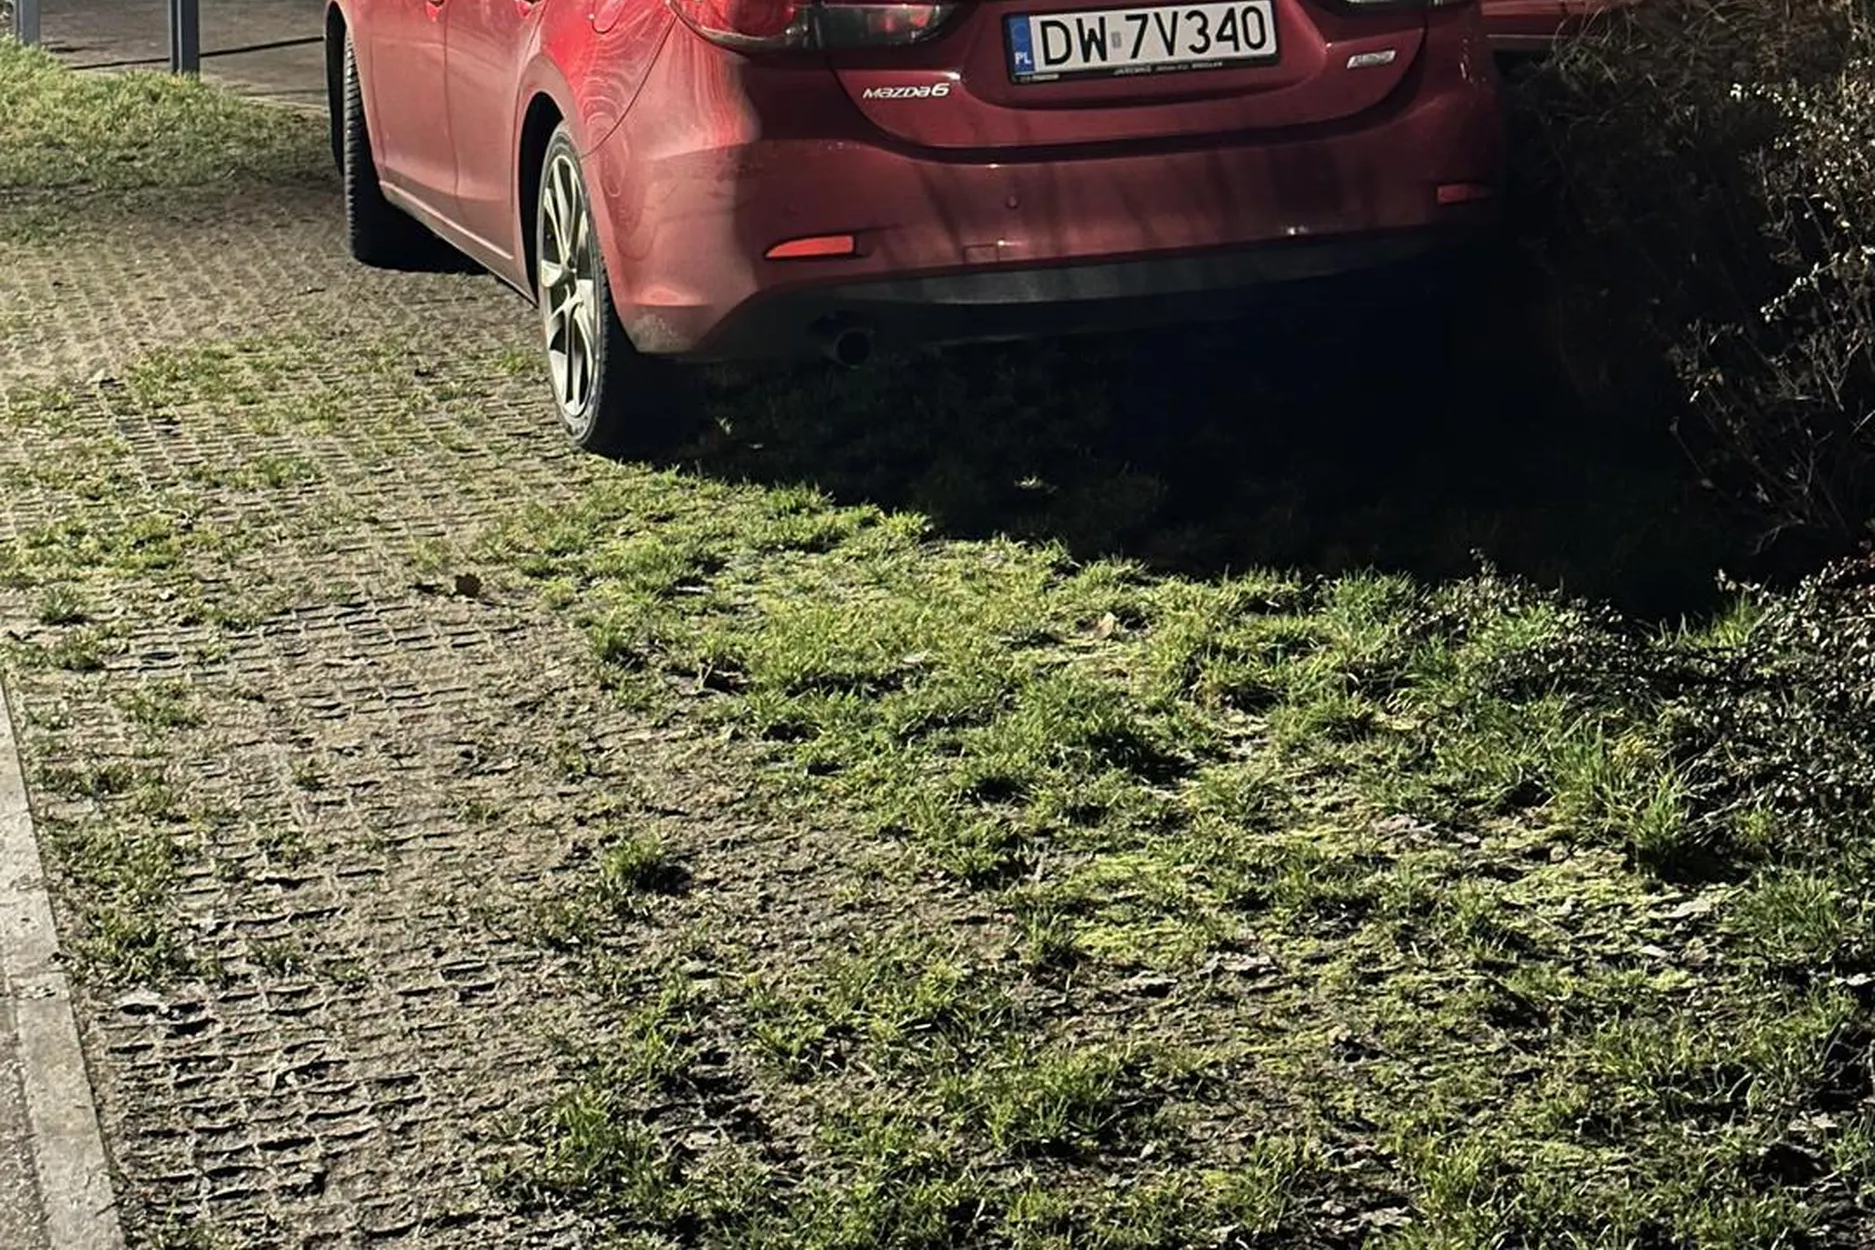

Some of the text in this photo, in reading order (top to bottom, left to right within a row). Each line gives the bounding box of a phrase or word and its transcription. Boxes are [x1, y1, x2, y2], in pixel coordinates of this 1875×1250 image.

[1040, 5, 1267, 66] DW 7V340
[1014, 52, 1032, 65] PL
